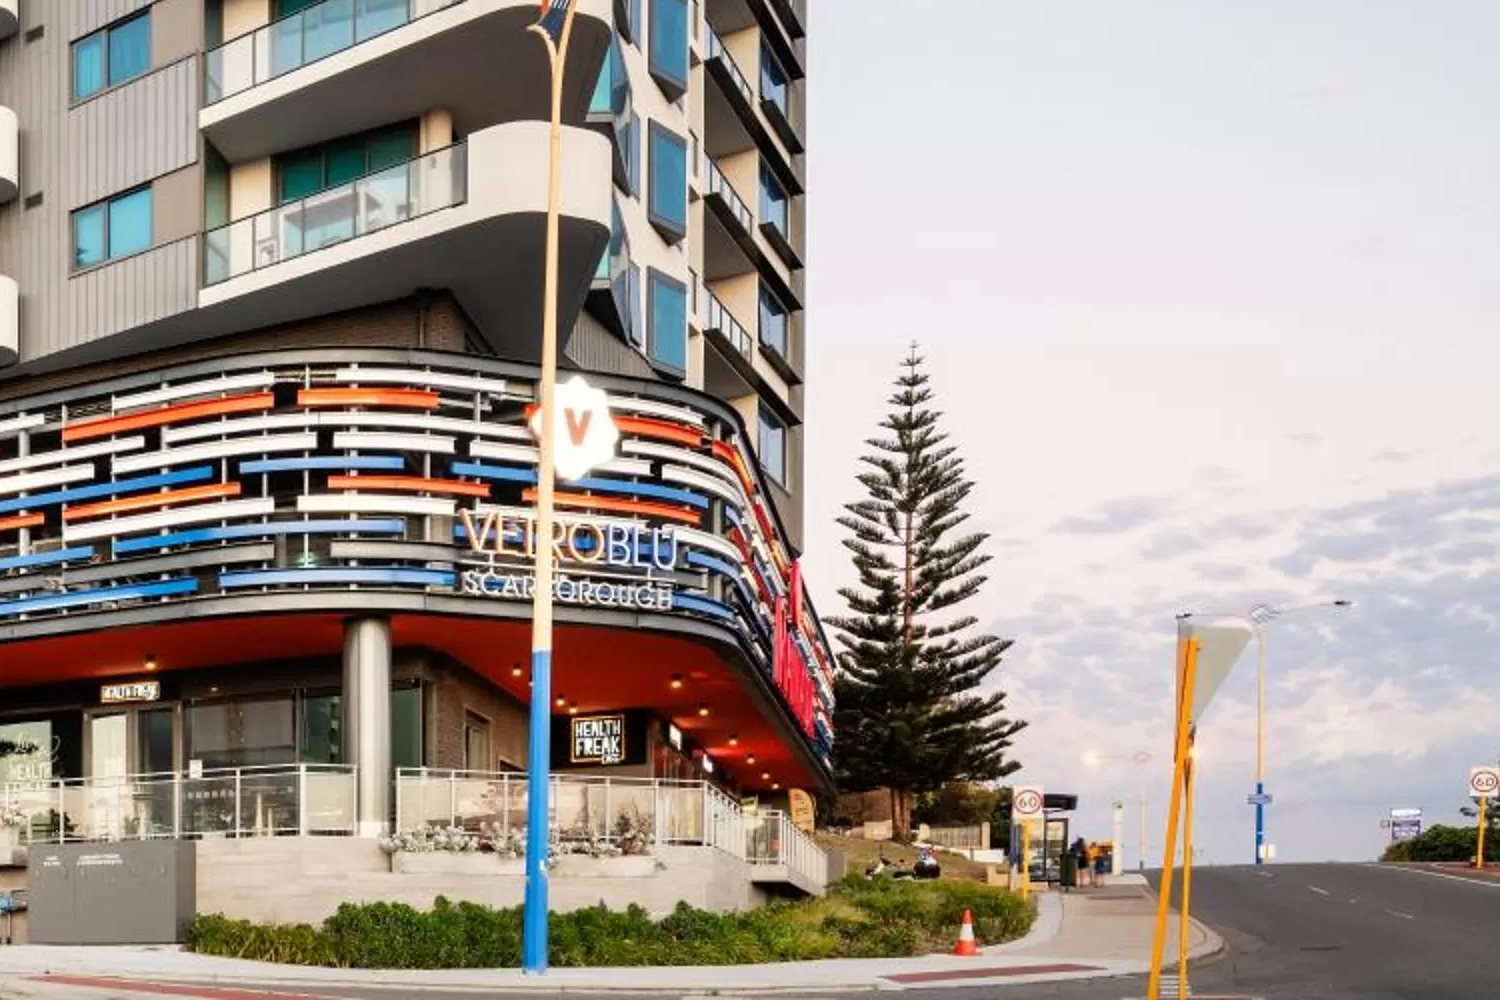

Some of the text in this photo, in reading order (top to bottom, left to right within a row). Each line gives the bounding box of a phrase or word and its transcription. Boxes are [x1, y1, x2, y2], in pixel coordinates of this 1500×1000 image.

[563, 407, 594, 448] V
[461, 570, 674, 609] SCAROROUGH
[575, 719, 621, 737] HEALTH
[575, 735, 621, 757] FREAK
[1473, 777, 1495, 787] 60
[1019, 796, 1037, 809] 60
